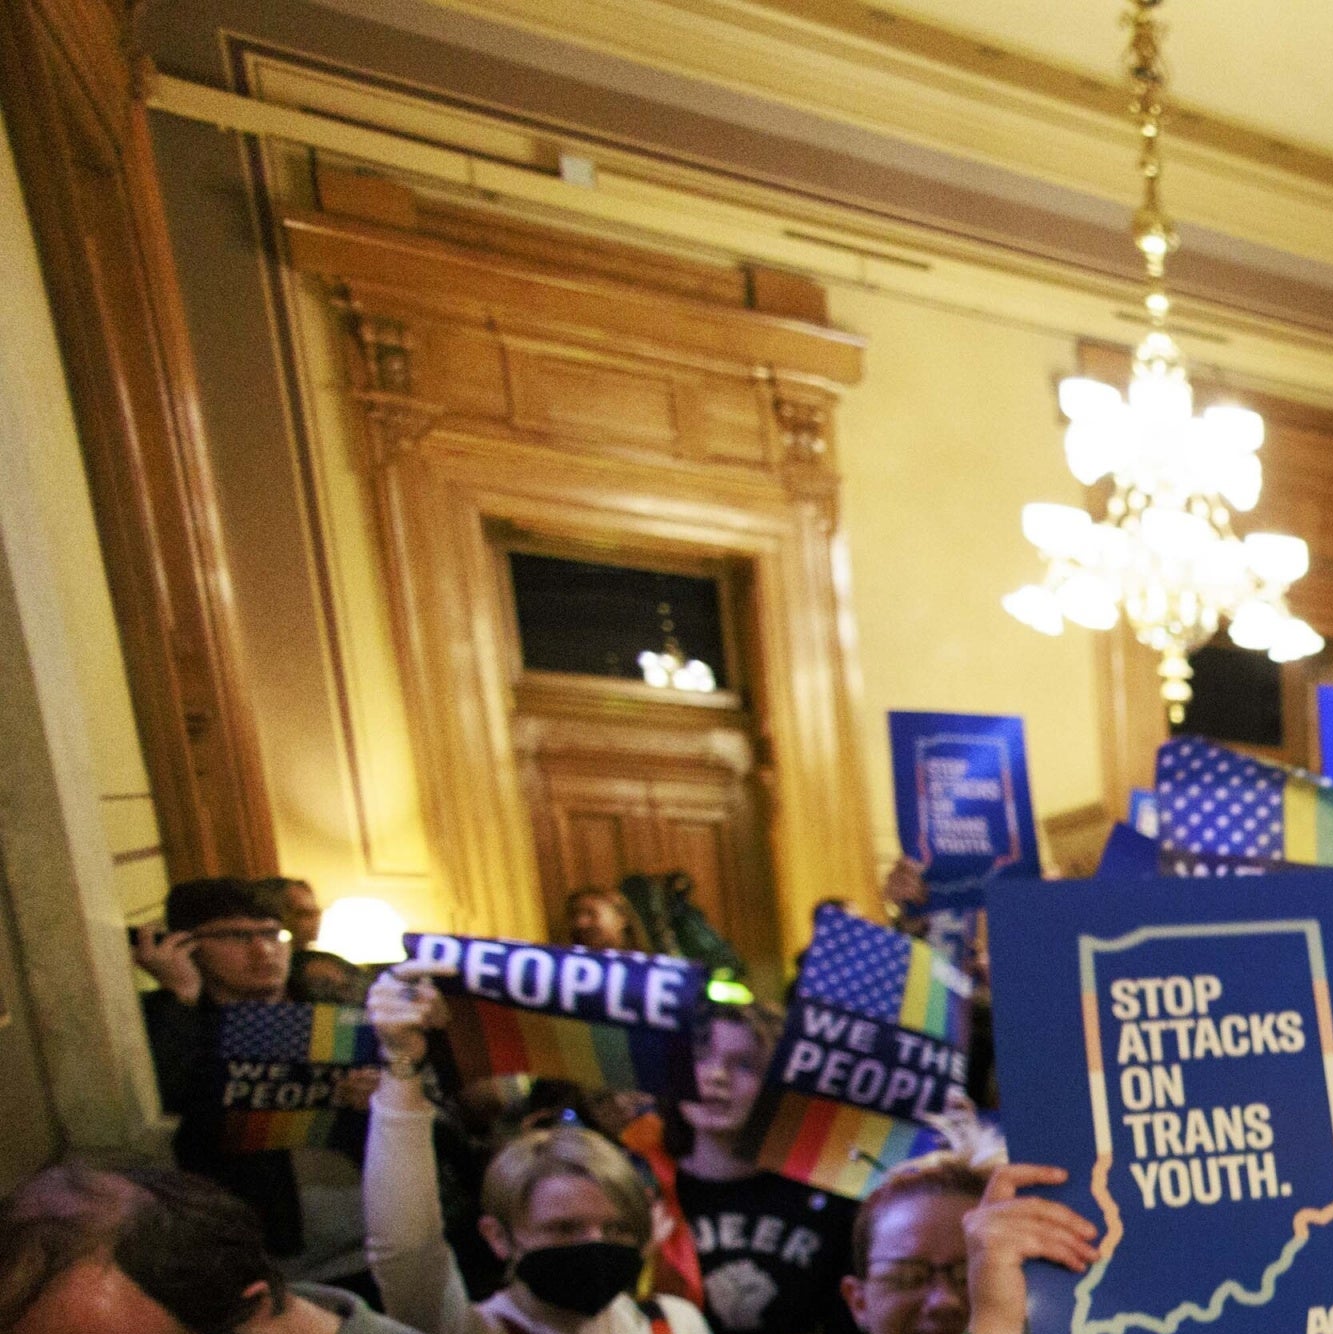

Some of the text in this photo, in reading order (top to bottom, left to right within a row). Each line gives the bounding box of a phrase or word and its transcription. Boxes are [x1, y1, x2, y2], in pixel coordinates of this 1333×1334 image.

[416, 934, 687, 1031] PEOPLE
[1111, 974, 1222, 1020] STOP
[801, 1005, 969, 1083] WE THE
[1117, 1010, 1305, 1064] ATTACKS
[223, 1079, 338, 1106] PEOP
[1121, 1064, 1185, 1111] ON
[1123, 1103, 1274, 1159] TRANS
[1130, 1152, 1293, 1209] YOUTH.
